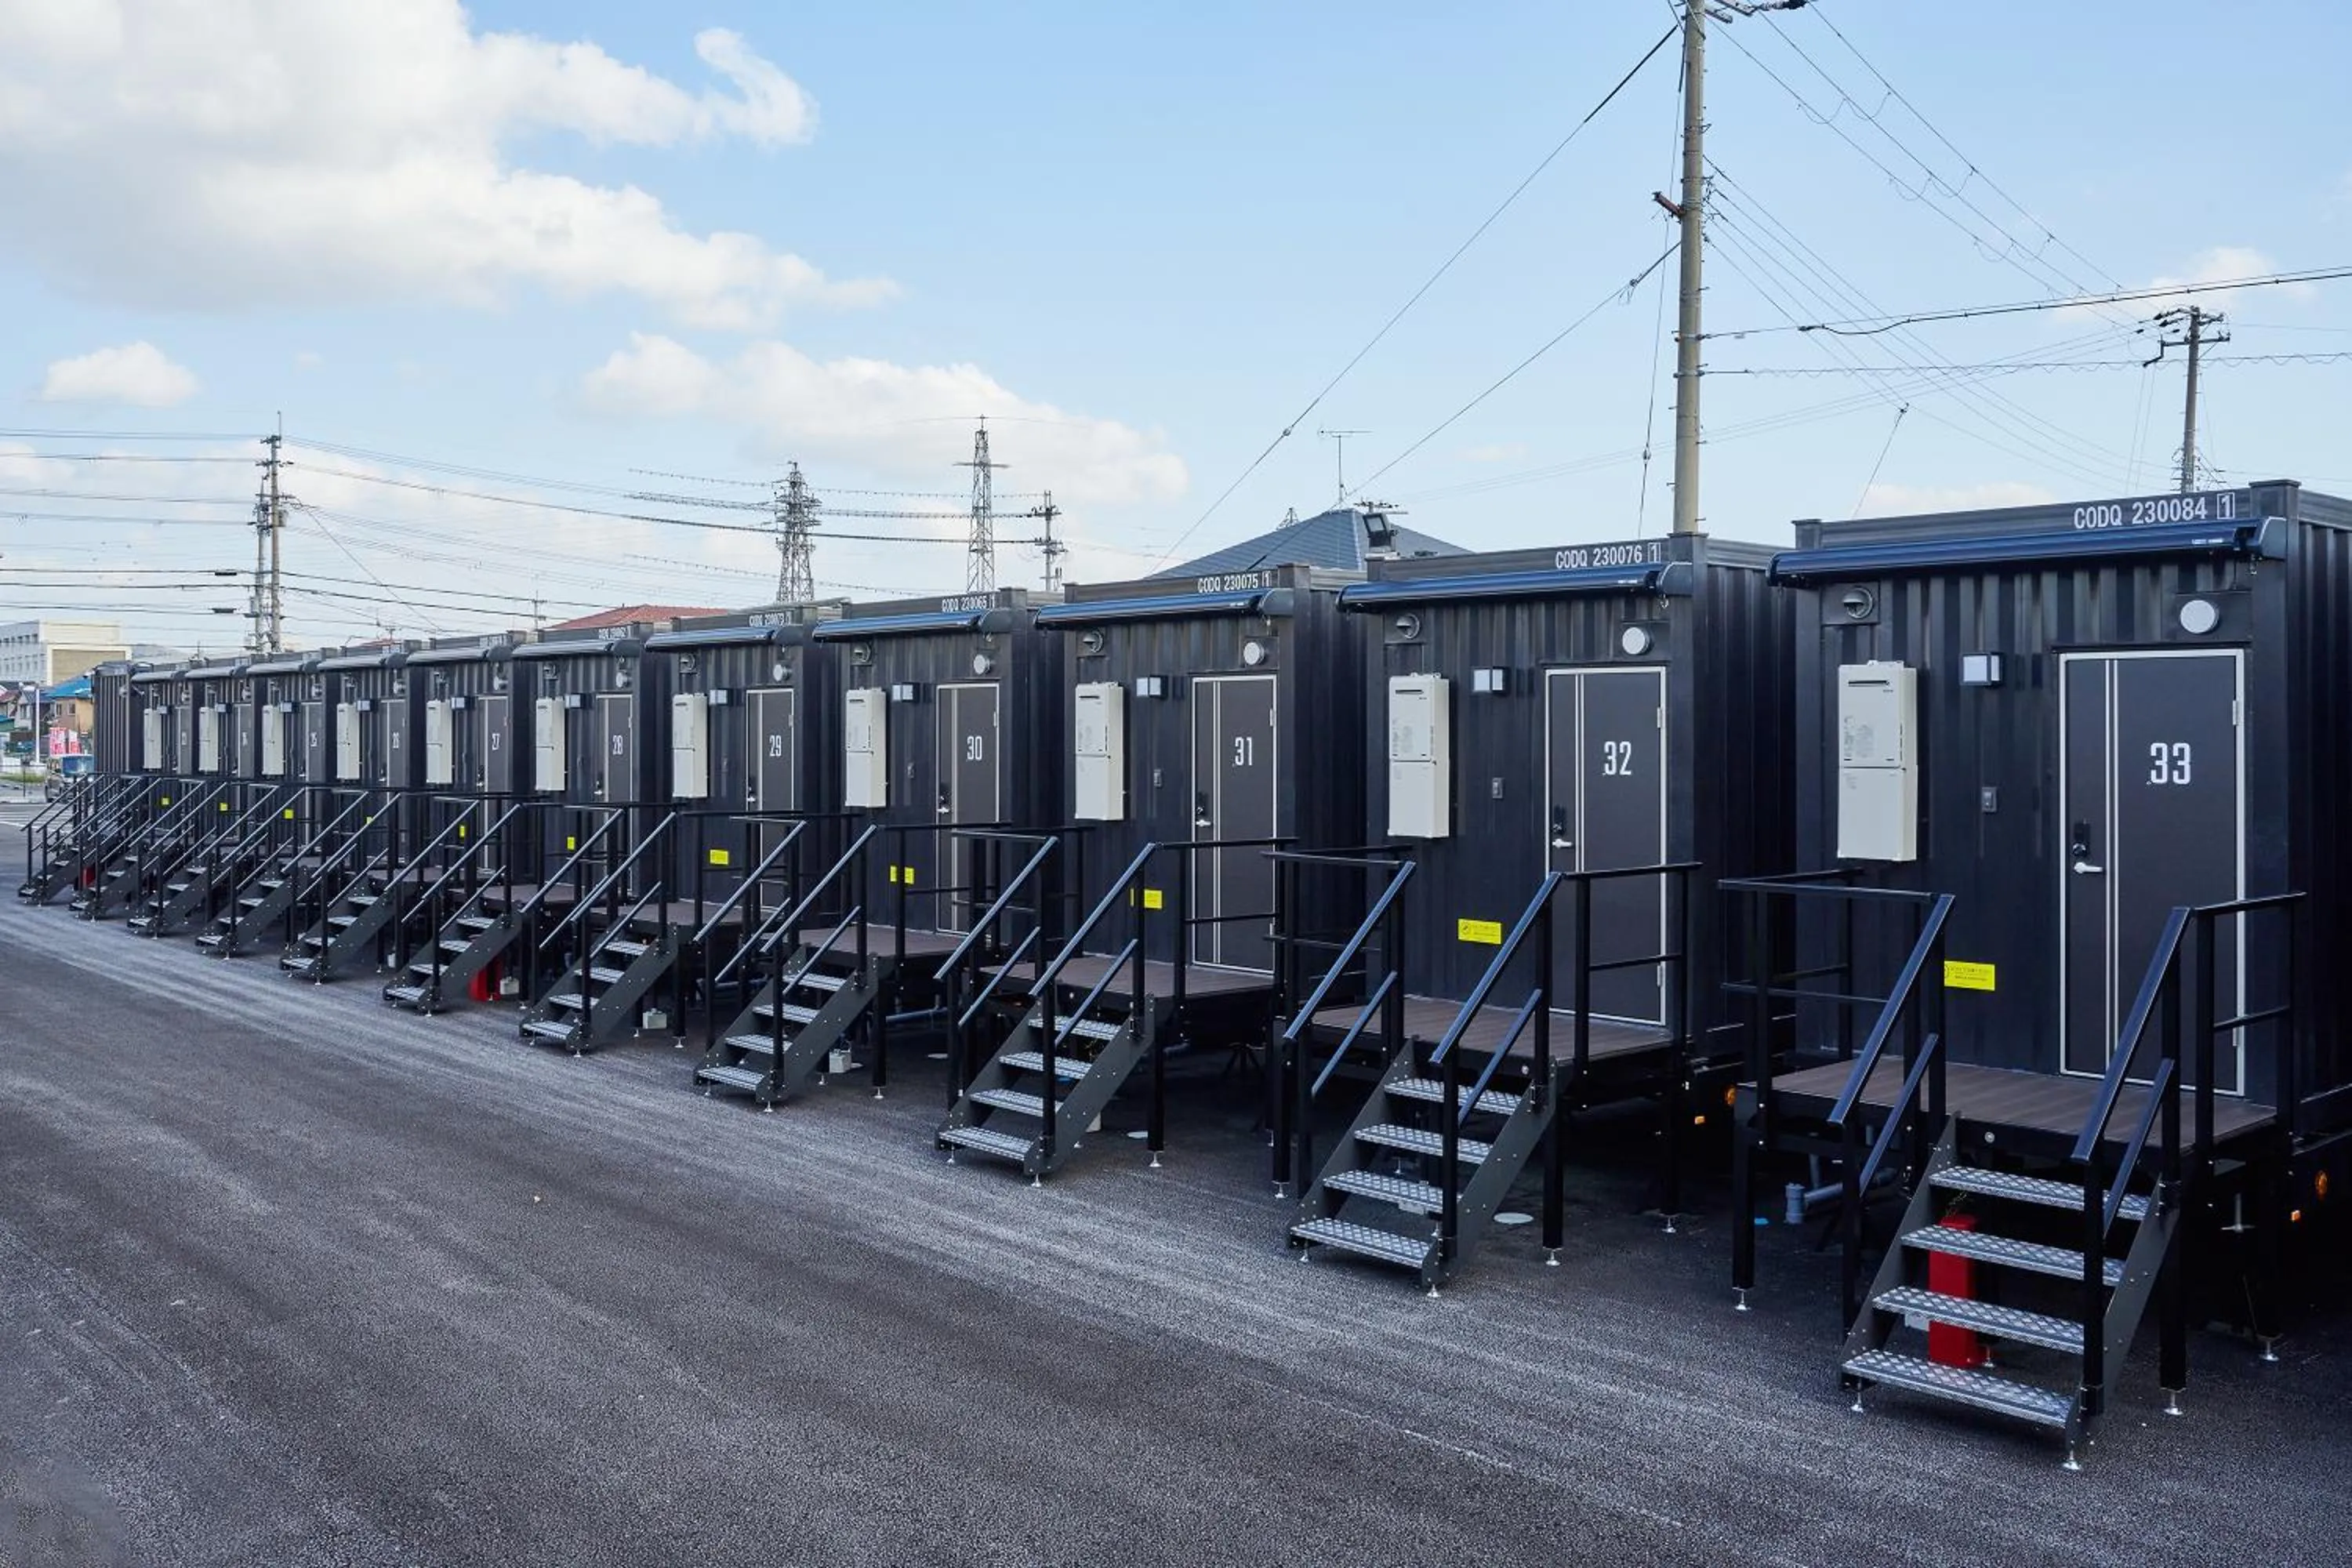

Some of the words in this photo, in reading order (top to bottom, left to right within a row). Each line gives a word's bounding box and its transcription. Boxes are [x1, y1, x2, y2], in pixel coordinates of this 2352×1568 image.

[2074, 504, 2122, 529] CODQ
[2132, 496, 2208, 524] 230084
[2219, 493, 2233, 518] 1
[1593, 545, 1643, 566] 230076
[1649, 543, 1660, 563] 1
[1224, 573, 1258, 590] 230075
[769, 735, 782, 757] 29
[967, 735, 982, 760] 30
[1235, 736, 1253, 766] 31
[1603, 741, 1632, 775] 32
[2150, 742, 2191, 785] 33
